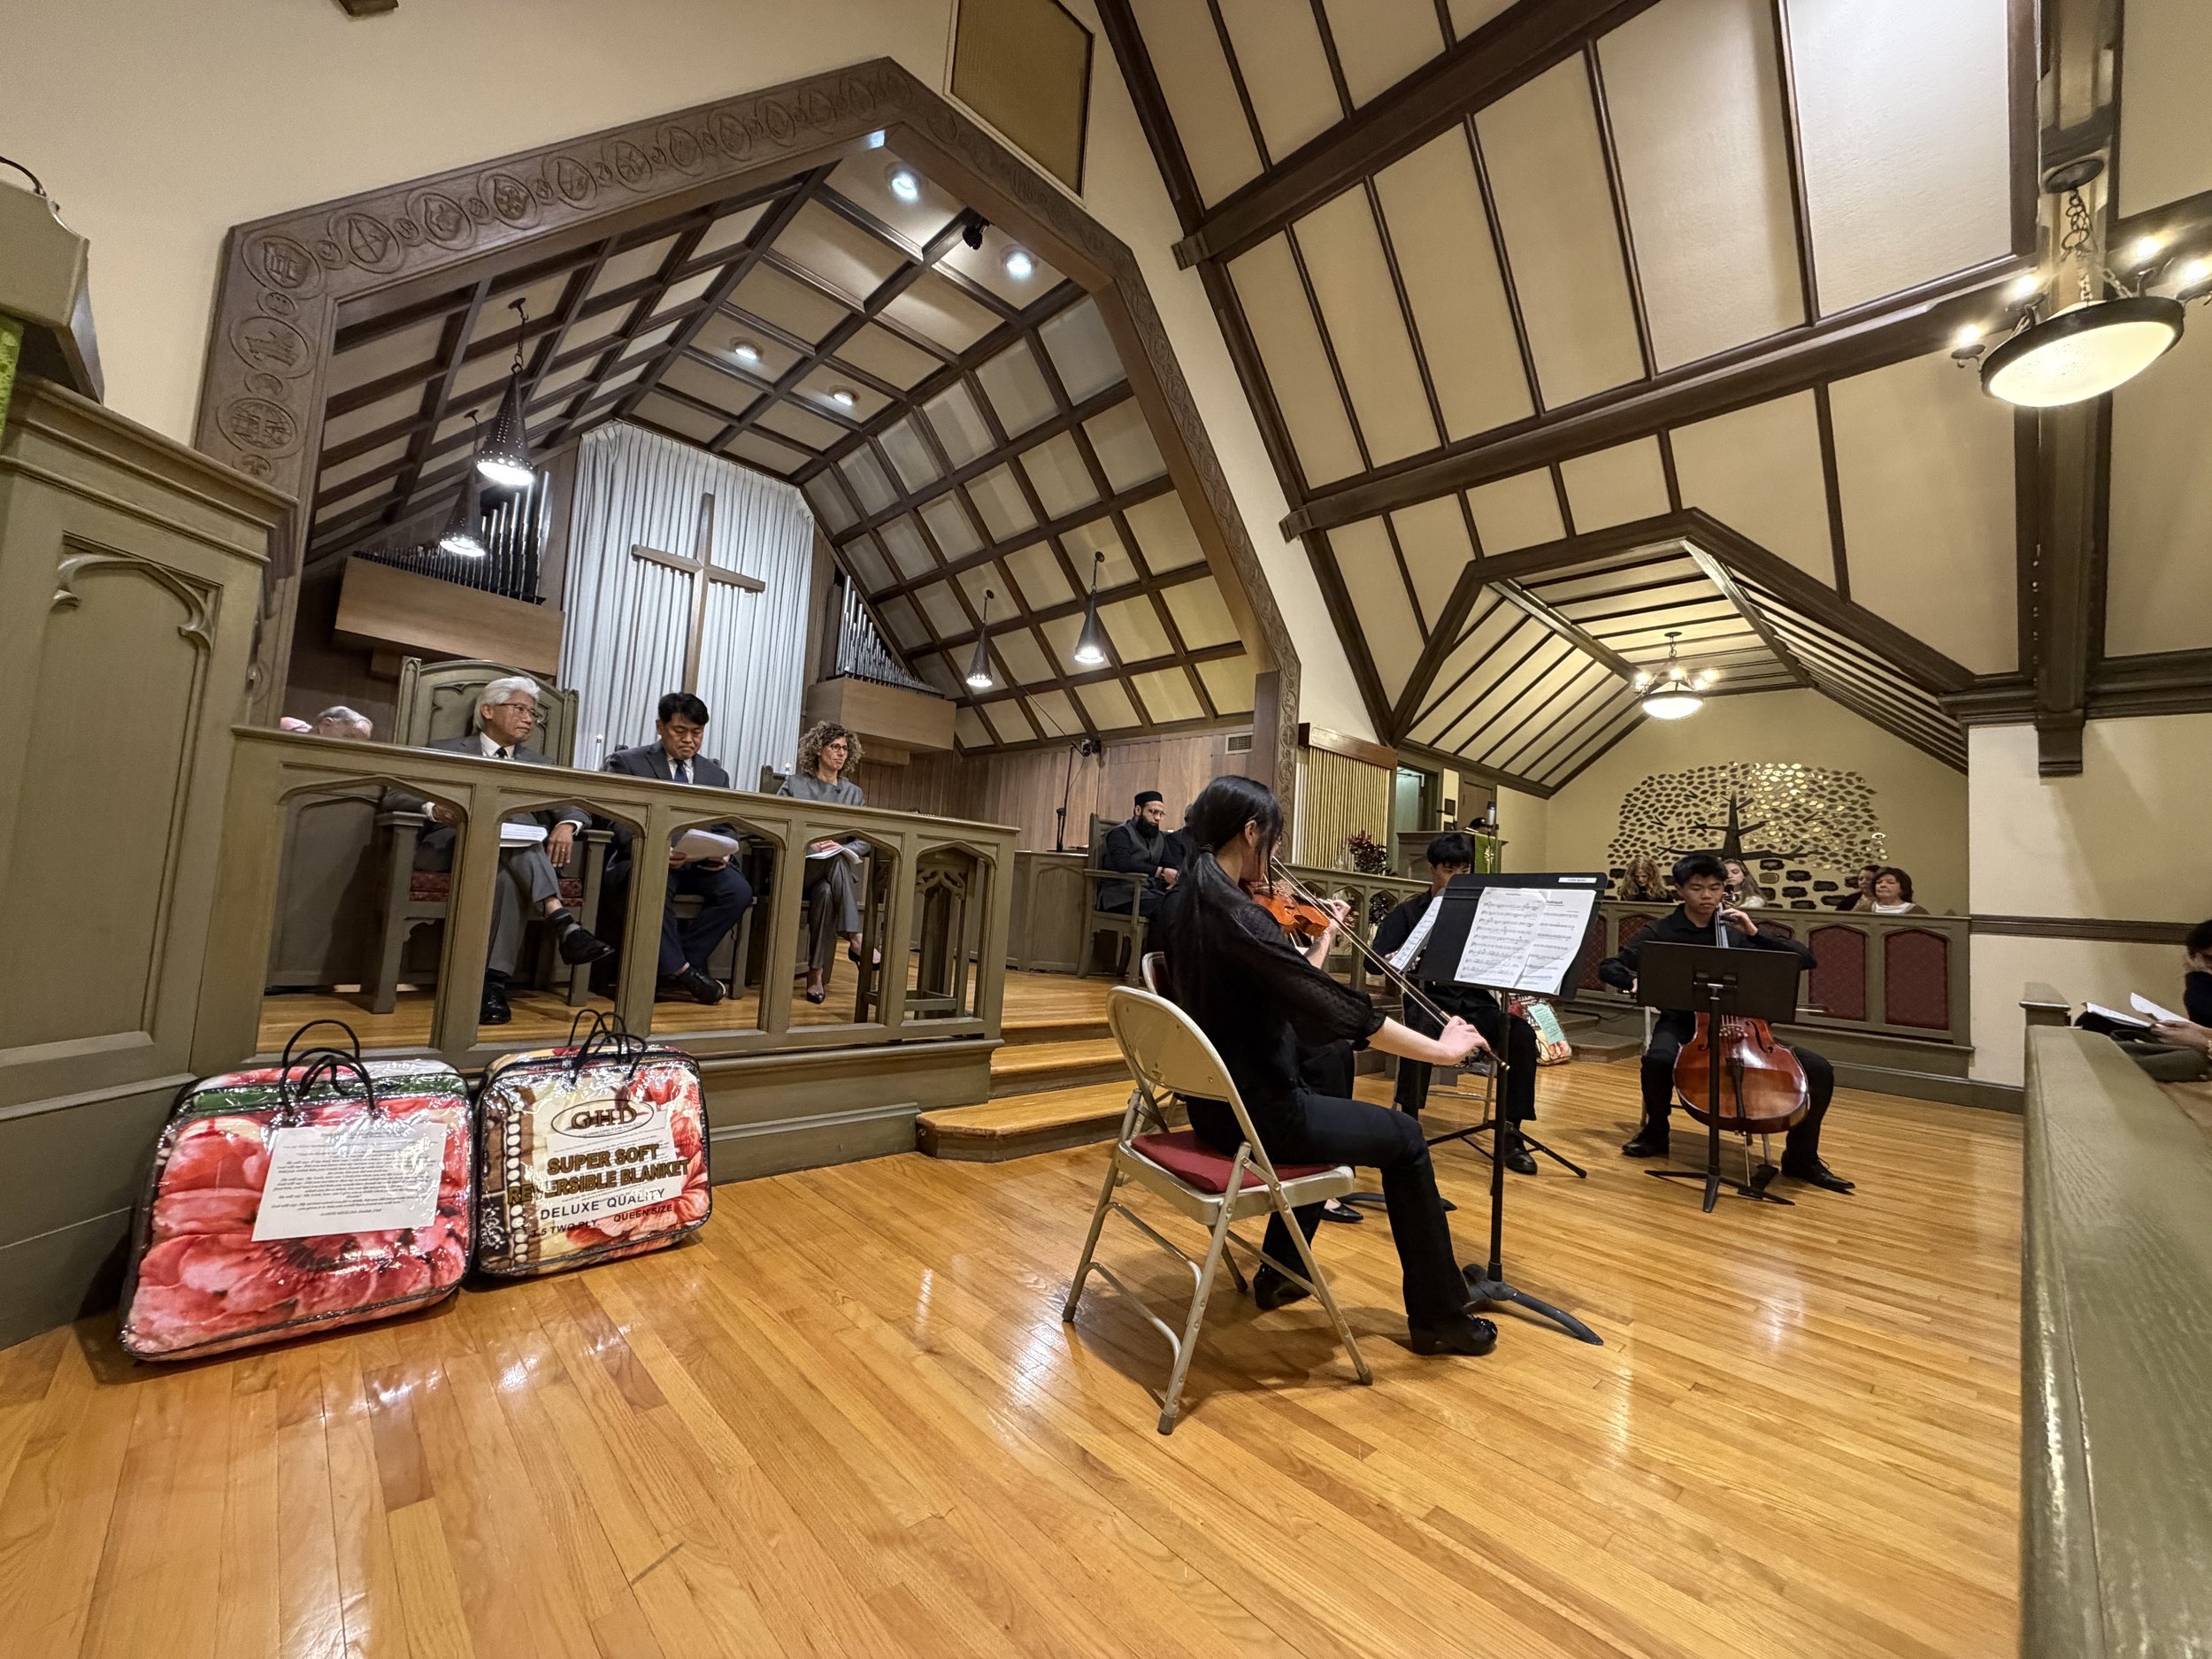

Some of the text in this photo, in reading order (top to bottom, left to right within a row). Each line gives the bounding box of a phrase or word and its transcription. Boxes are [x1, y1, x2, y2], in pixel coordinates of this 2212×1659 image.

[571, 1107, 638, 1130] GHD
[547, 1150, 611, 1175] SUPER
[614, 1143, 660, 1165] SOFT
[620, 1159, 690, 1187] BLANKET
[540, 1201, 600, 1220] DELUXE
[613, 1203, 672, 1223] QUEEN SIZE
